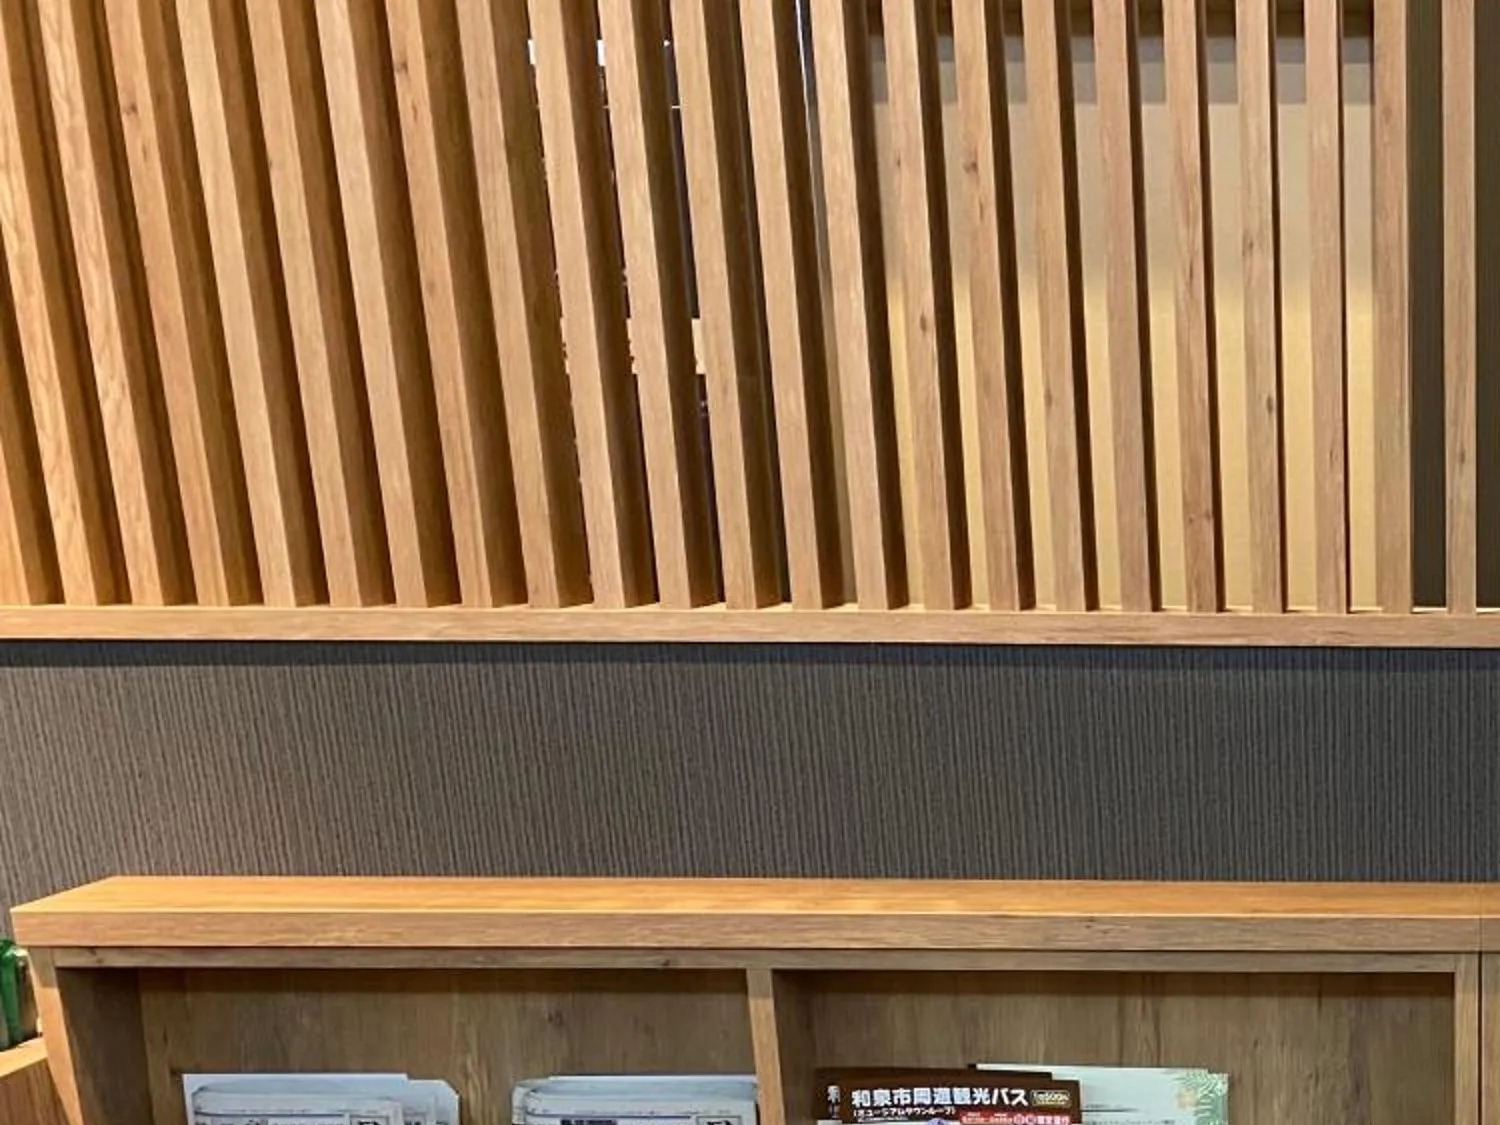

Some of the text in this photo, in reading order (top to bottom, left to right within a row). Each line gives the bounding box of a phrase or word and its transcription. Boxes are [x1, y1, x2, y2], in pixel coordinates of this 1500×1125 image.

[851, 1087, 1028, 1107] 和泉市周遊観光バス
